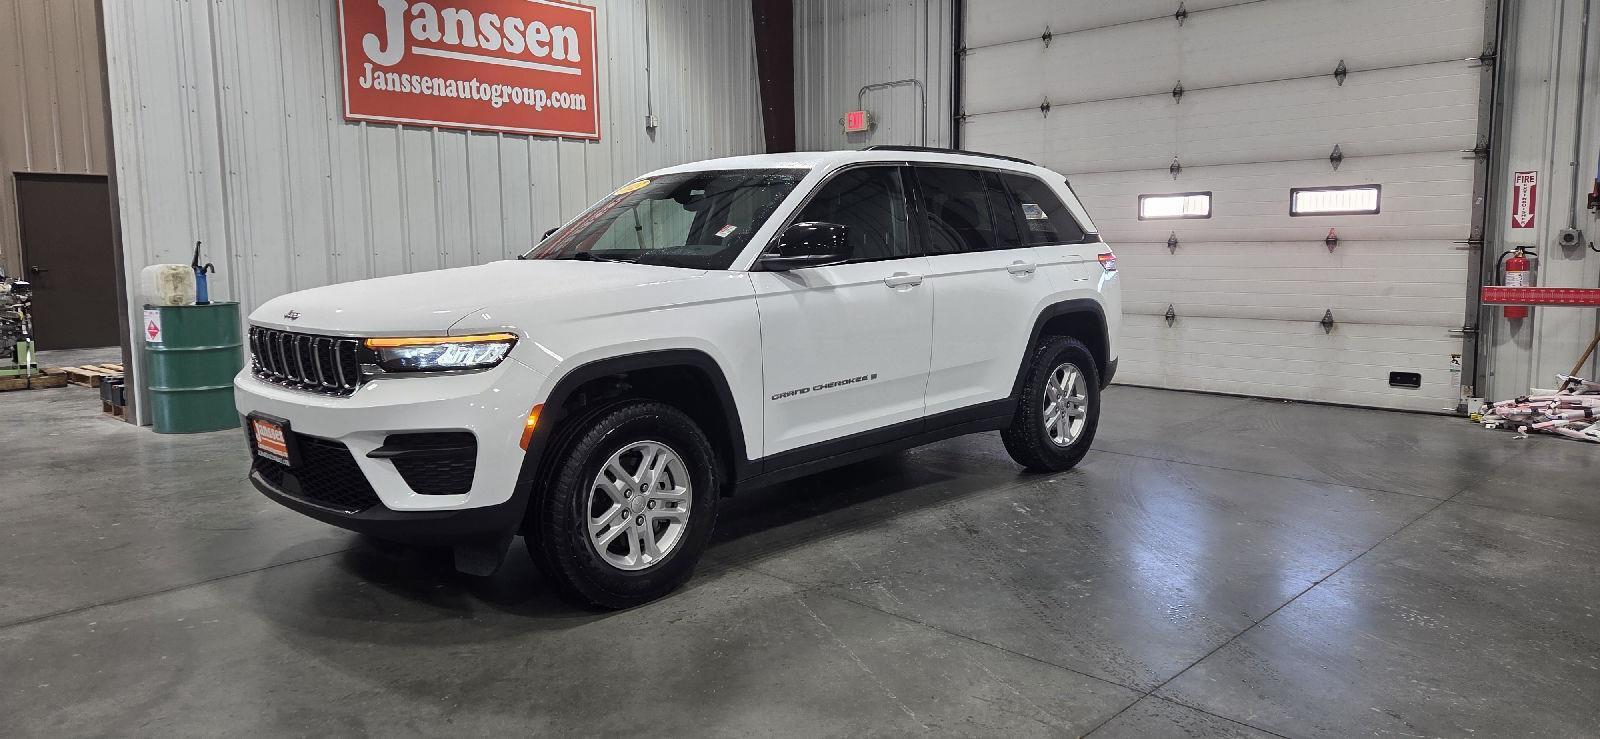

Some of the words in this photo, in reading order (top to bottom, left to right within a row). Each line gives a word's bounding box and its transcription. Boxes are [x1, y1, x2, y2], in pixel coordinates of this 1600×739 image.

[362, 0, 581, 66] Janssen
[359, 63, 587, 111] Janssenautogroup.com
[1516, 175, 1535, 183] FIRE
[771, 387, 811, 401] GRAND
[812, 375, 868, 391] CHEROKEE
